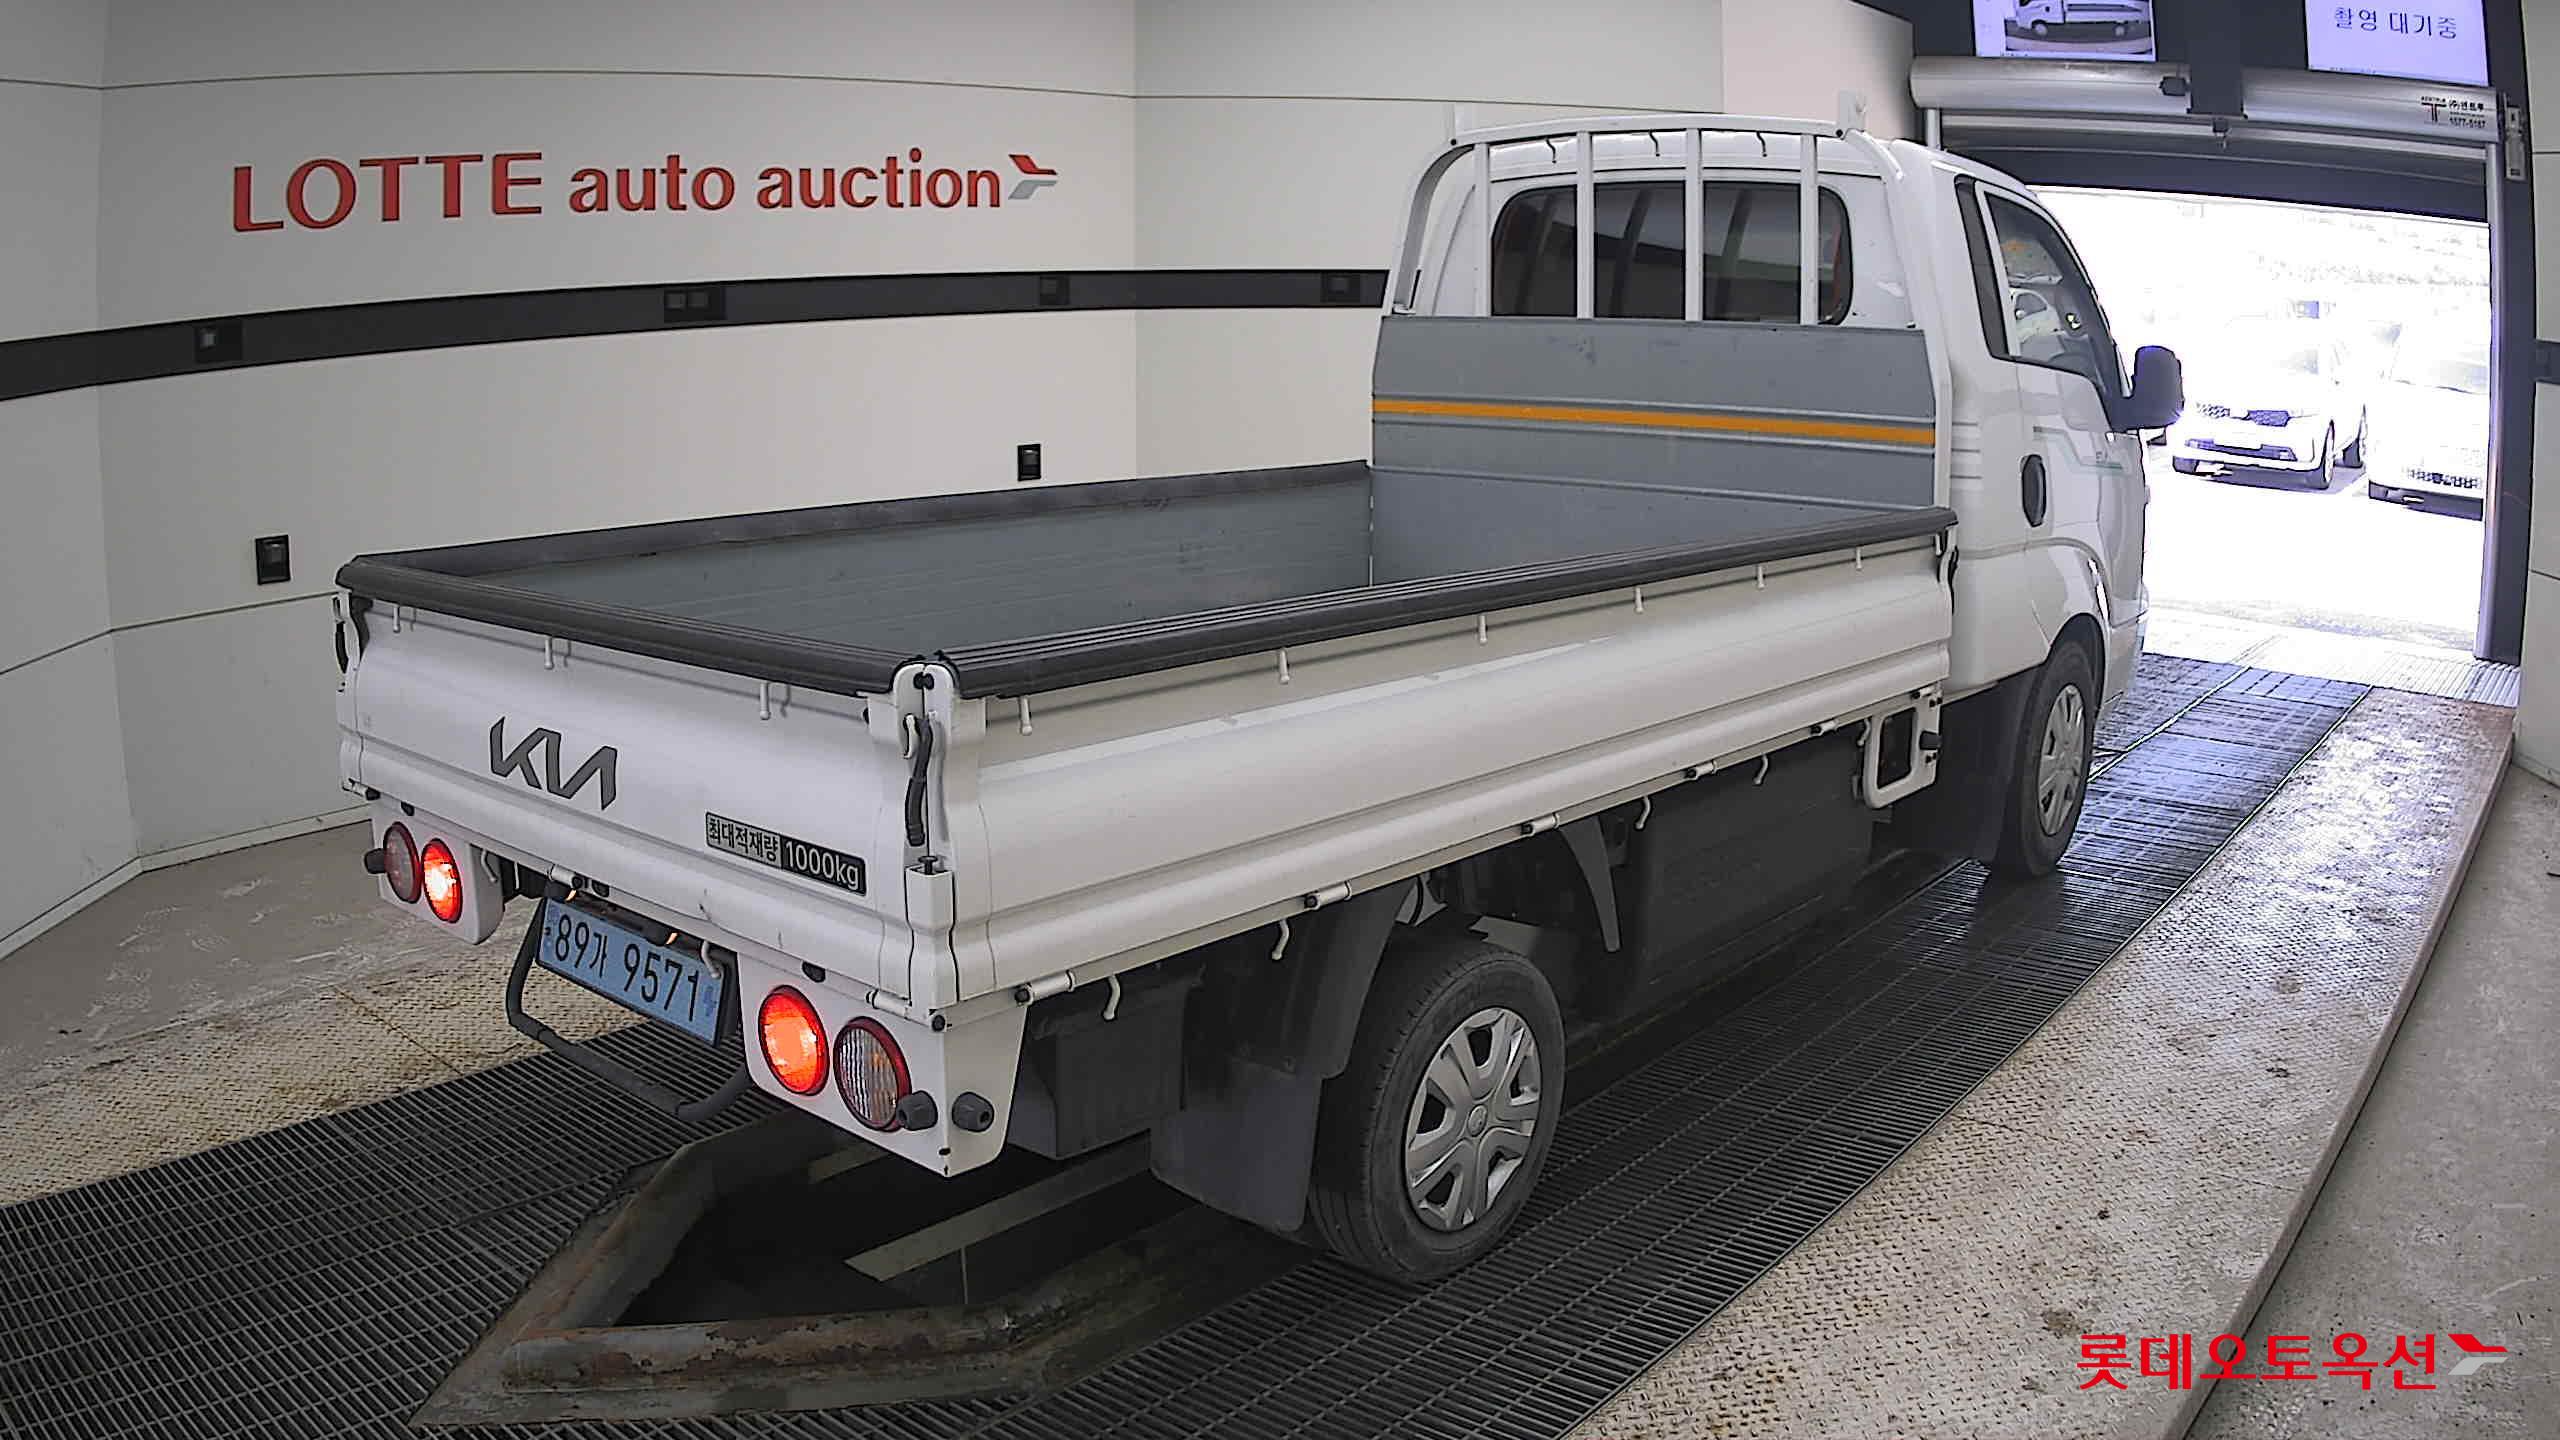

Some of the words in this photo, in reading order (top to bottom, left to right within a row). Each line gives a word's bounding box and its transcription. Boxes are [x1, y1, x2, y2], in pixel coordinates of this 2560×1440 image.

[2335, 7, 2378, 32] 촬영
[2389, 12, 2457, 40] 대기중
[233, 151, 541, 232] LOTTE
[569, 154, 737, 214] auto
[756, 148, 1002, 209] auction
[489, 716, 618, 811] KIA
[708, 816, 779, 862] 최대적재량
[785, 840, 860, 891] 1000kg
[555, 914, 608, 979] 89가
[623, 943, 700, 1022] 9571
